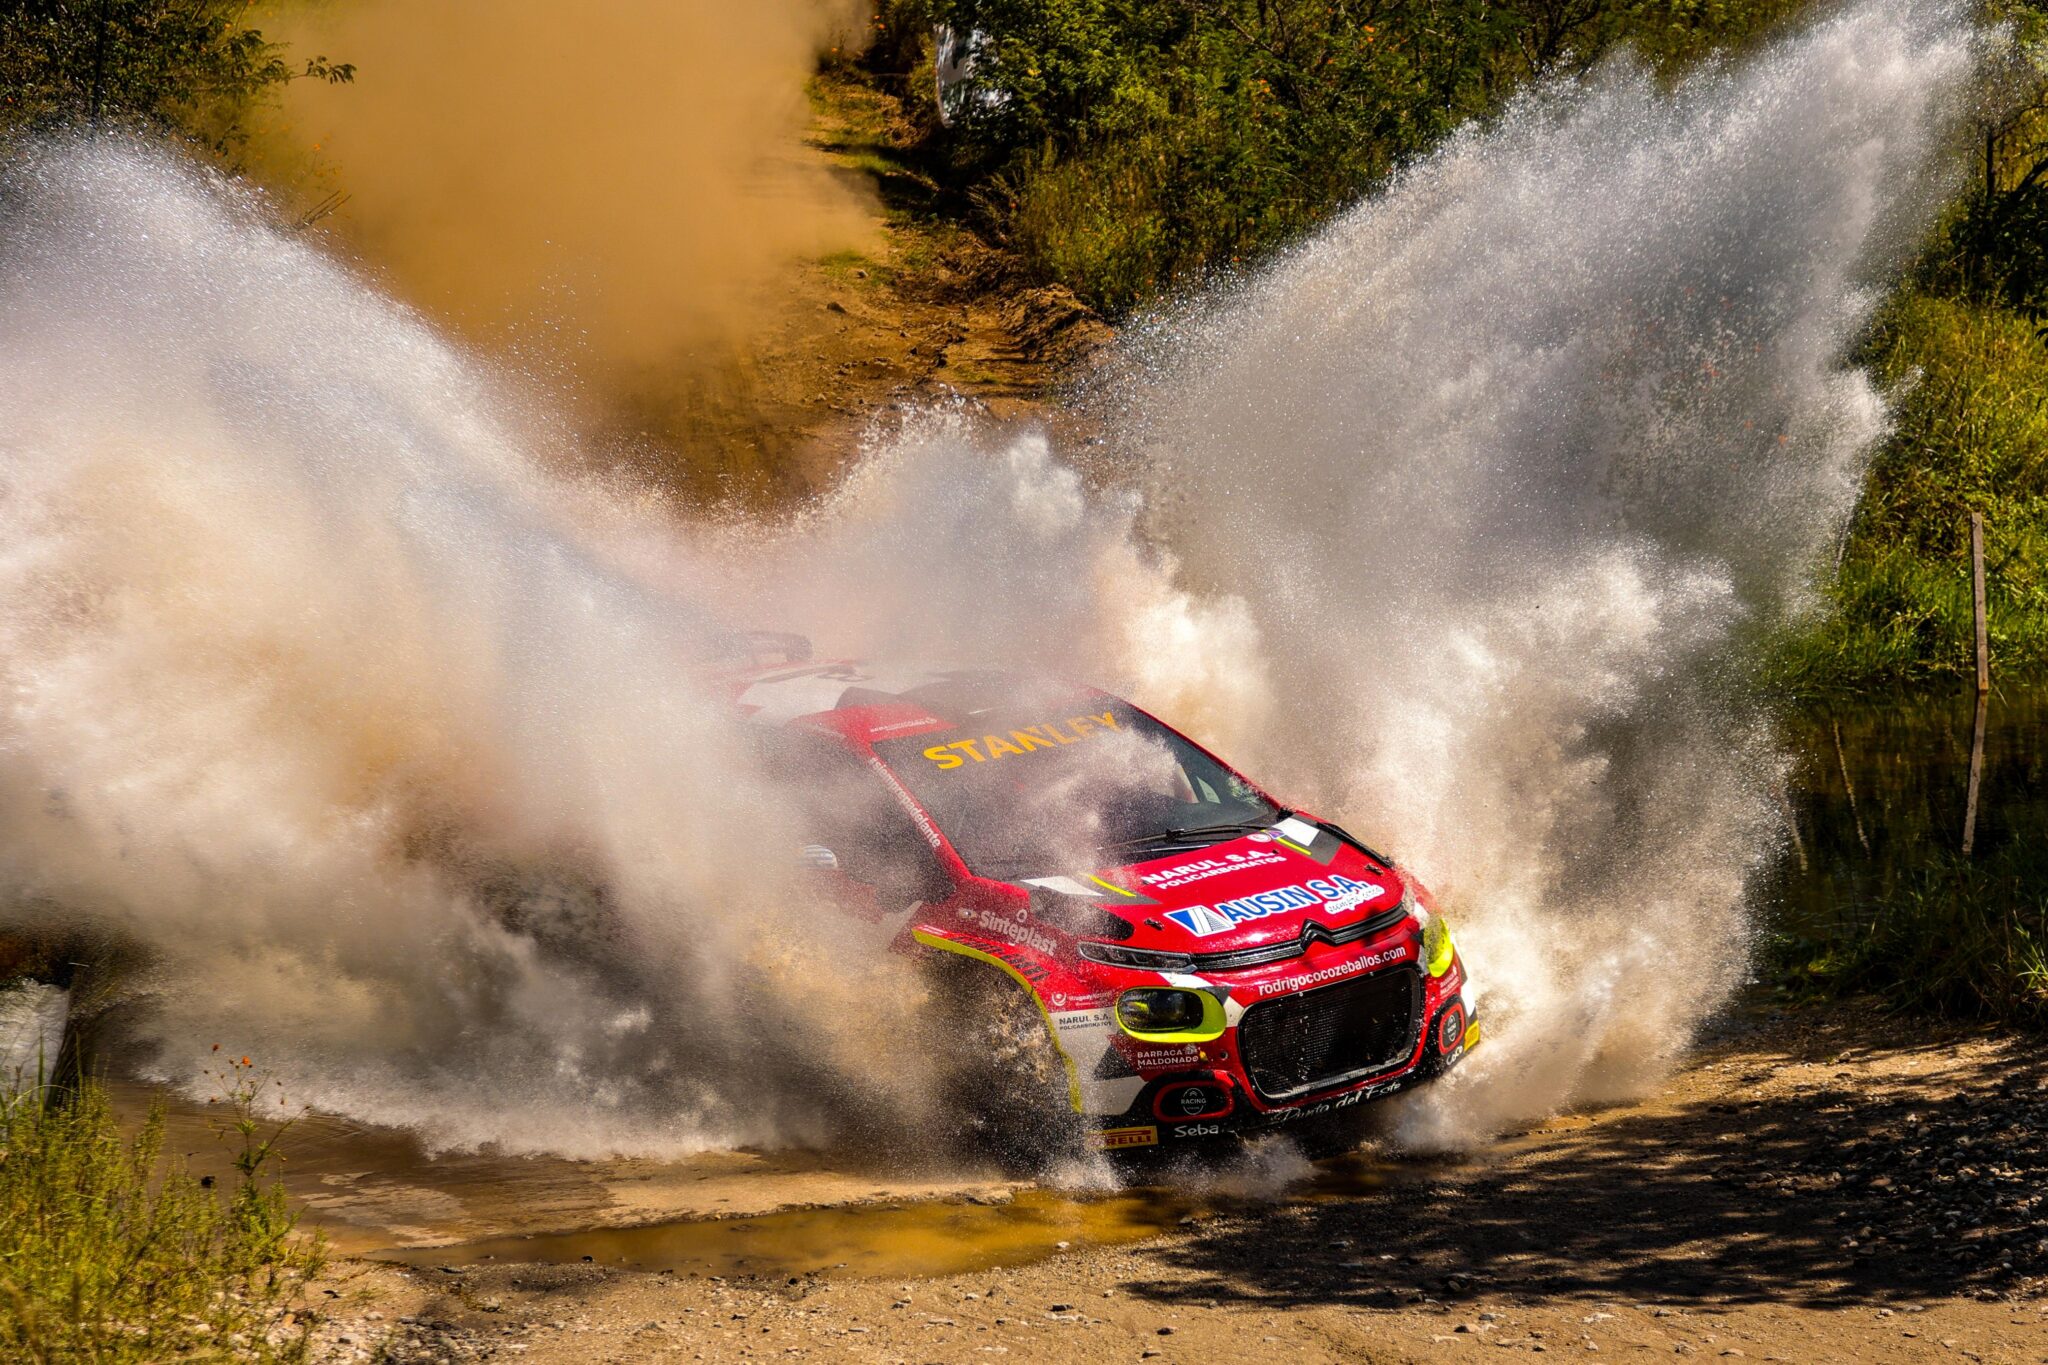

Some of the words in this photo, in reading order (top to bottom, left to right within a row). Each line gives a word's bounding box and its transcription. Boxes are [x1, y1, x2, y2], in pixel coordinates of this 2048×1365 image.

[923, 711, 1123, 769] STANLEY
[1141, 860, 1228, 884] NARUL
[1225, 850, 1275, 863] S.A.
[1157, 856, 1287, 889] POLICARBONATOS
[1217, 886, 1319, 922] AUSIN
[1310, 876, 1369, 898] S.A.
[979, 910, 1058, 956] Sinteplast
[1258, 946, 1407, 996] rodrigococozeballos.com
[1137, 1050, 1183, 1058] BARRACA
[1137, 1056, 1199, 1066] MALDONADO
[1174, 1124, 1219, 1137] Seba
